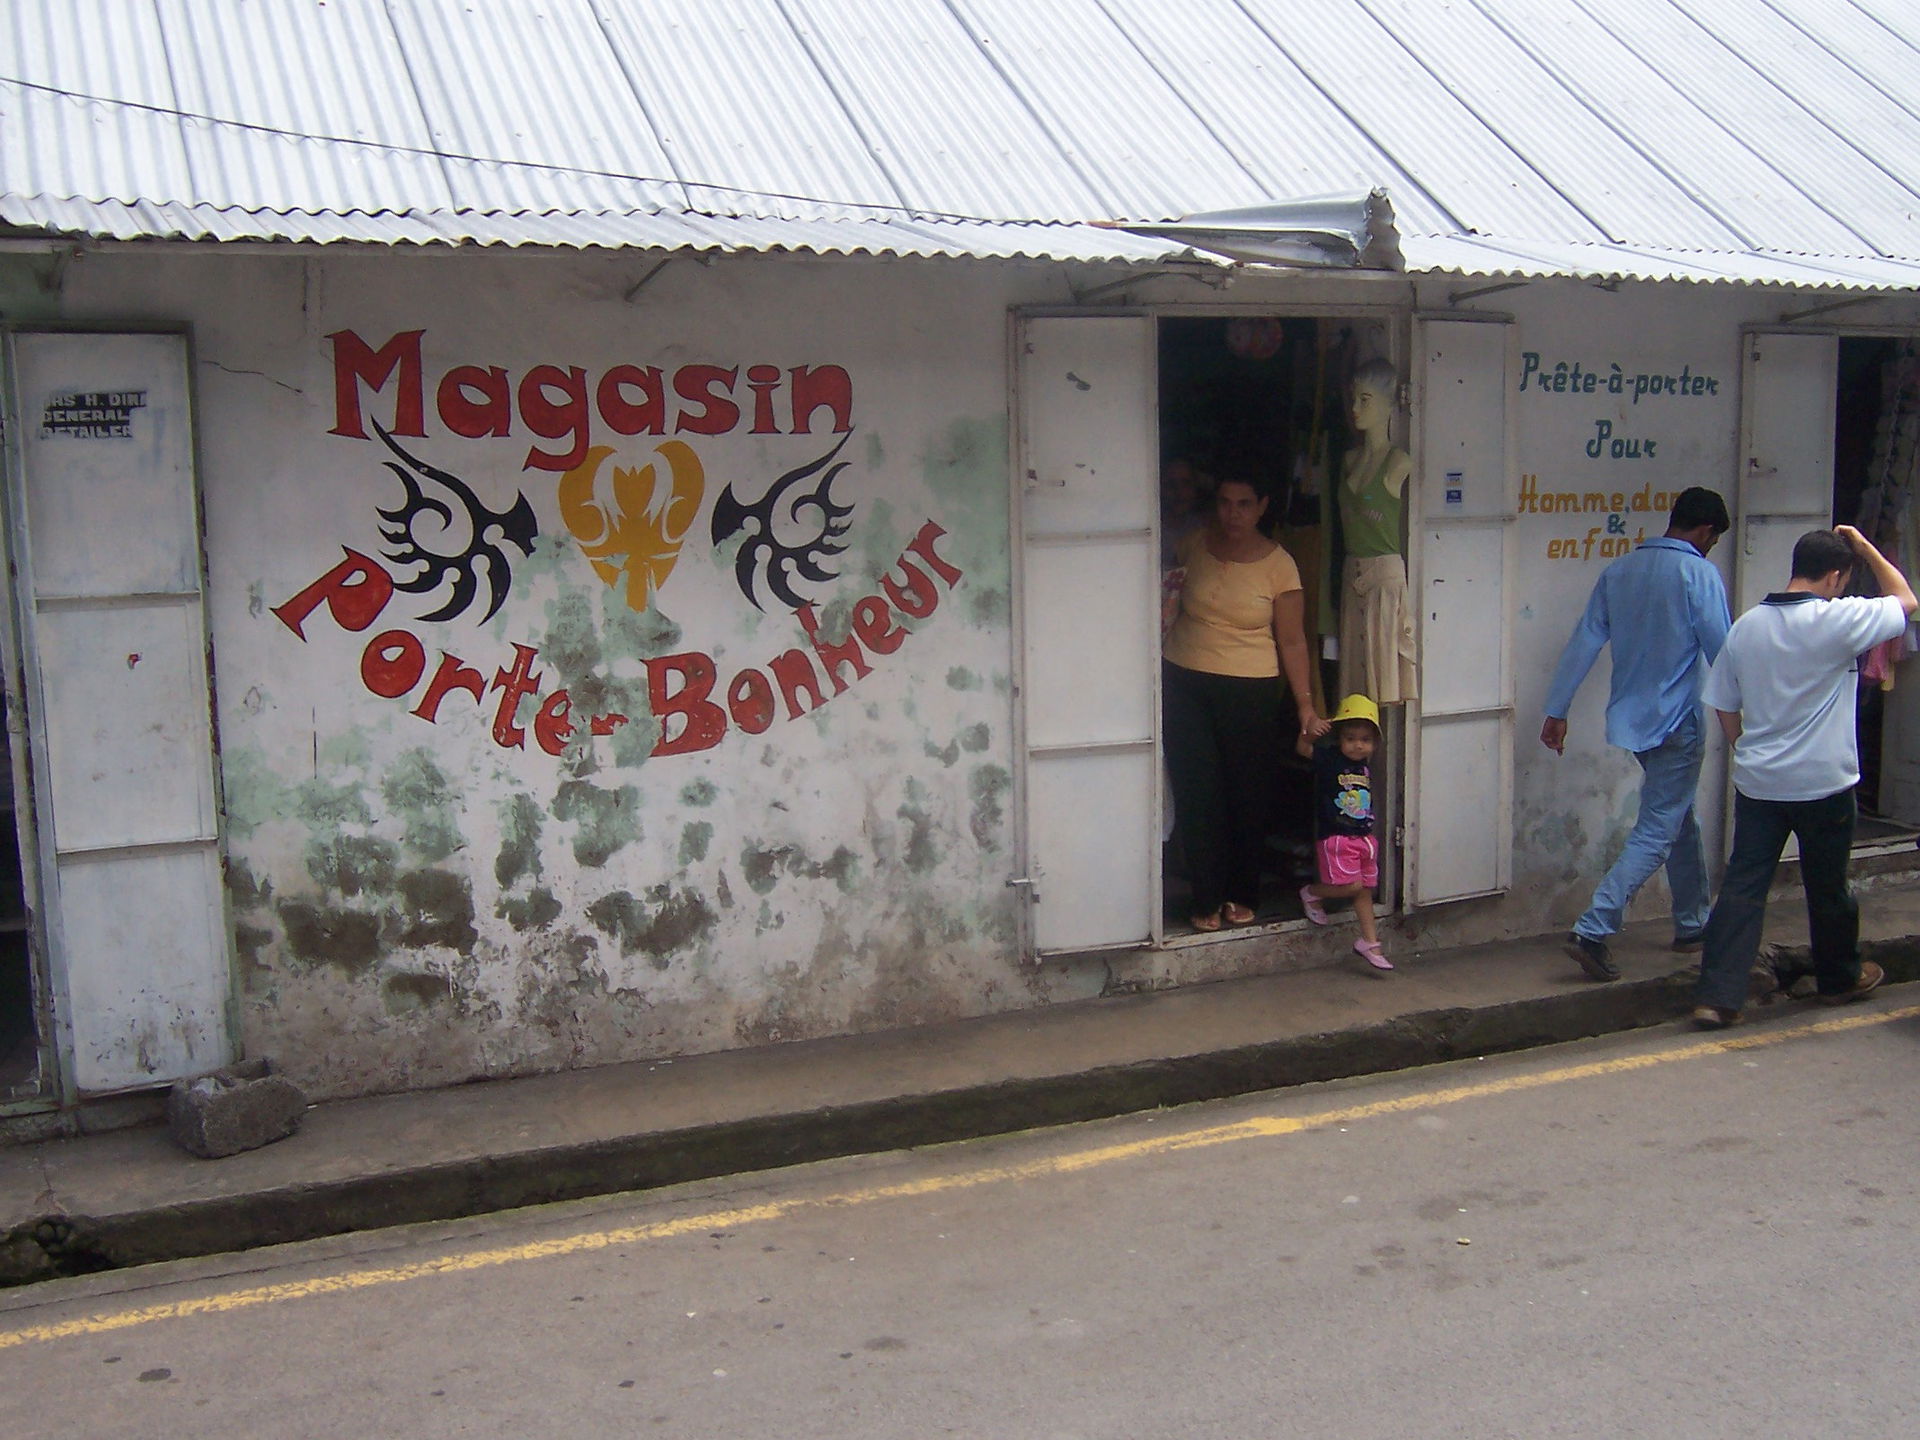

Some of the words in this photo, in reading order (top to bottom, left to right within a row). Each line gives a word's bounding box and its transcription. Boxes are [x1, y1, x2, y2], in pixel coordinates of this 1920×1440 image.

[324, 329, 854, 471] Magasin
[1519, 352, 1720, 405] Prête-à-porter
[1586, 420, 1657, 459] Pour
[1607, 513, 1626, 536] &
